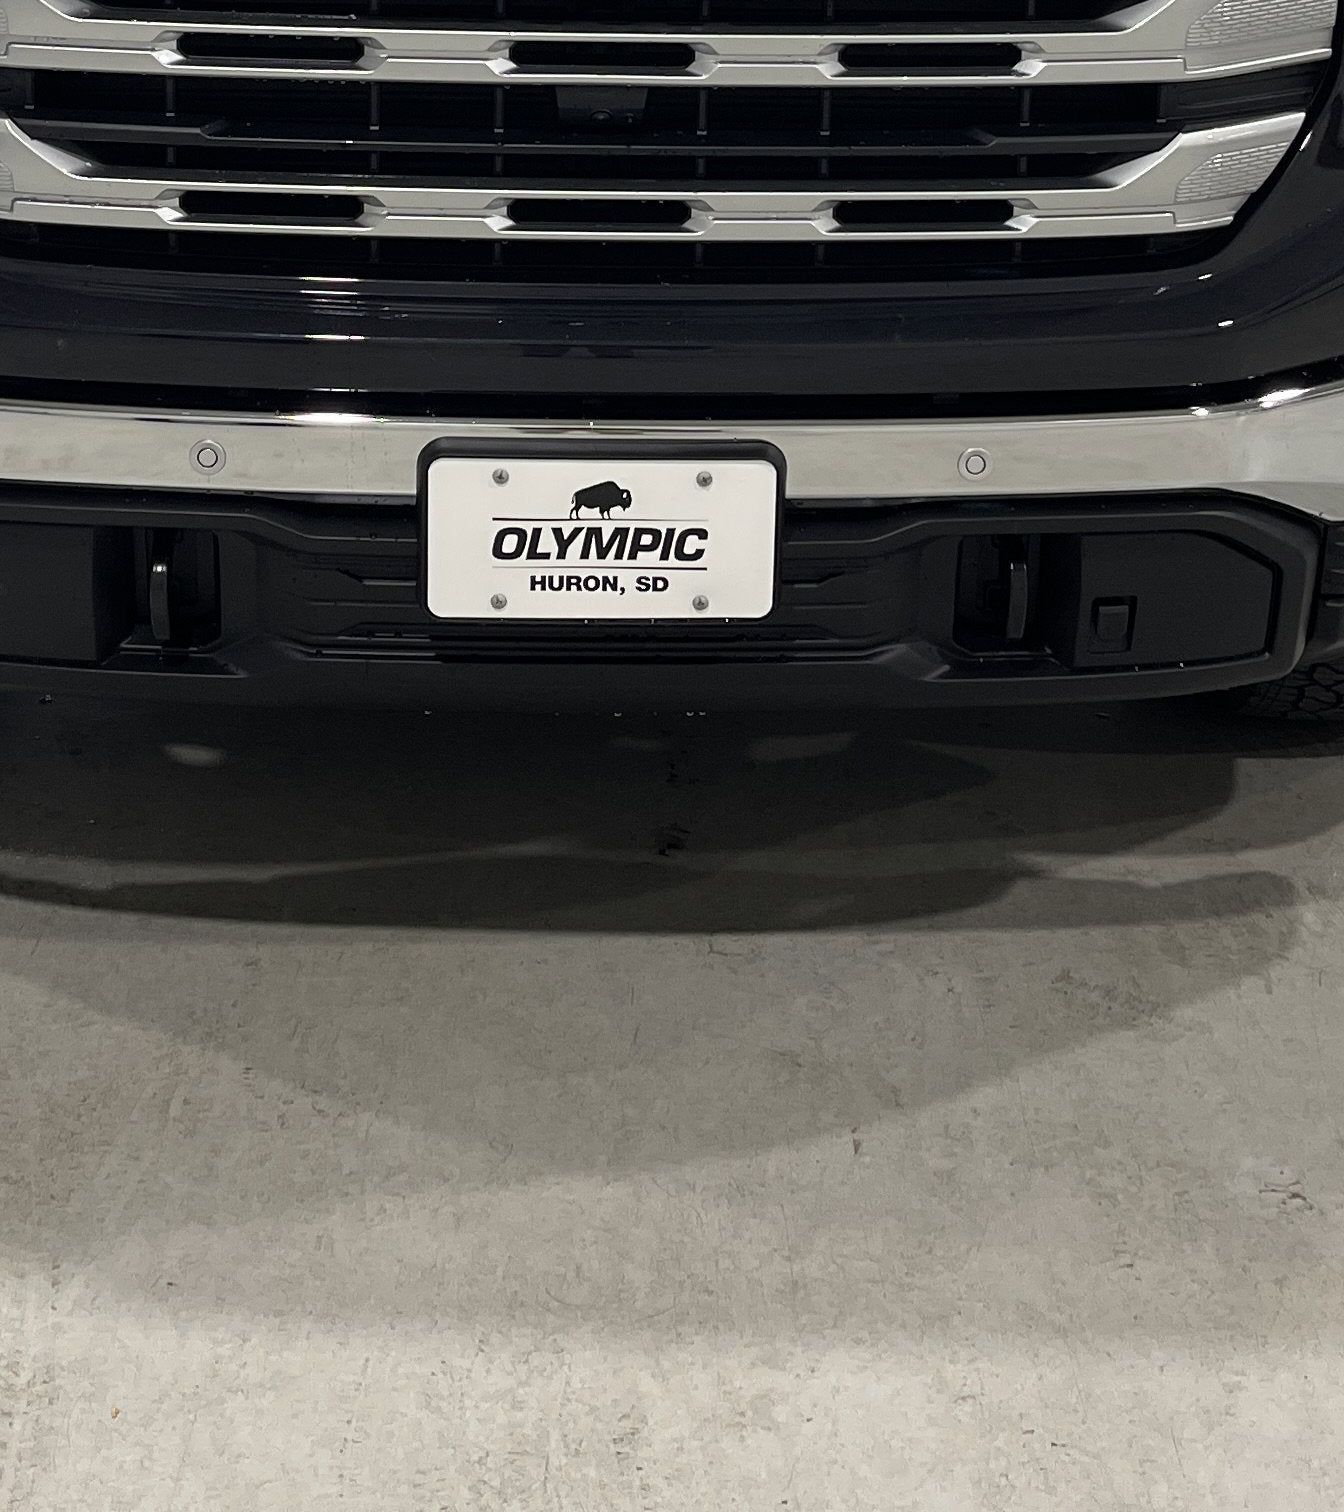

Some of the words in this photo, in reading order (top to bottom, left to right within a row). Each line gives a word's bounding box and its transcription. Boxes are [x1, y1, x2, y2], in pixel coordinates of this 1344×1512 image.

[492, 526, 708, 562] OLYMPIC
[529, 574, 626, 596] HURON,
[635, 575, 670, 593] SD
